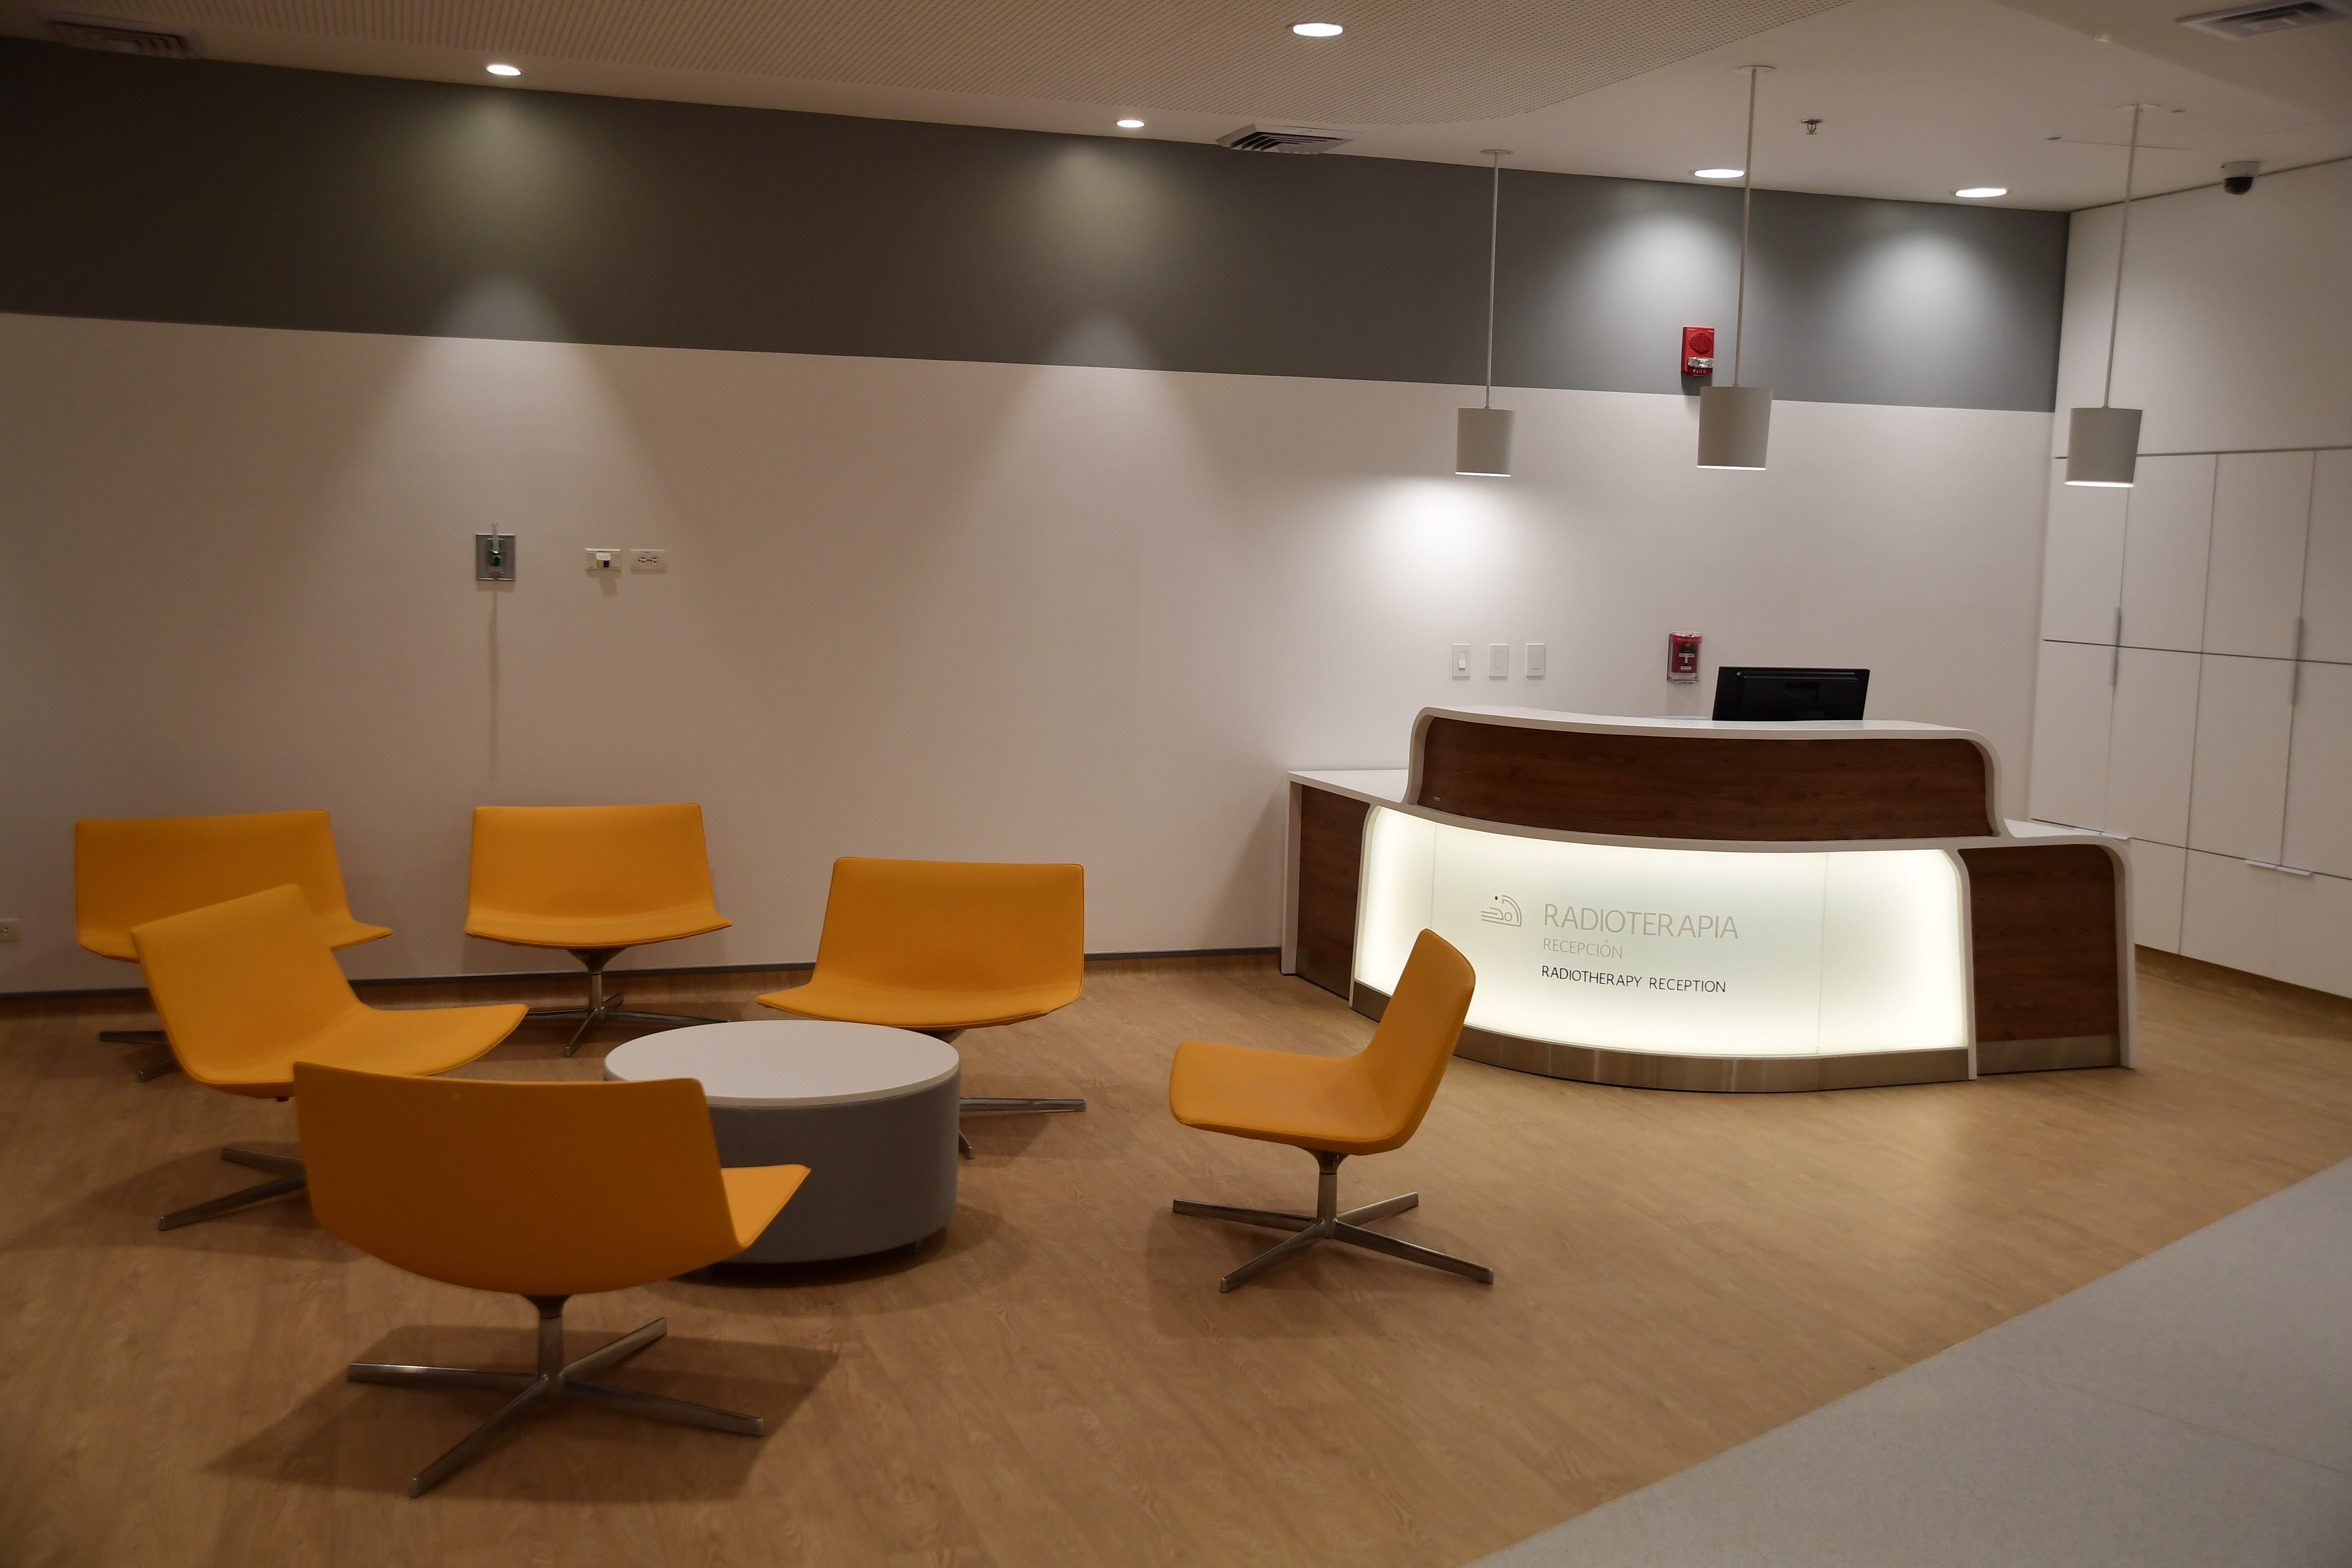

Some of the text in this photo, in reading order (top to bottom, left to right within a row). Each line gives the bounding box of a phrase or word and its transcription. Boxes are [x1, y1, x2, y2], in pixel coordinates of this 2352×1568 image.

[1544, 903, 1739, 939] RADIOTERAPIA
[1543, 937, 1623, 959] RECEPCIÓN
[1541, 965, 1726, 994] RADIOTHERAPY RECEPTION
